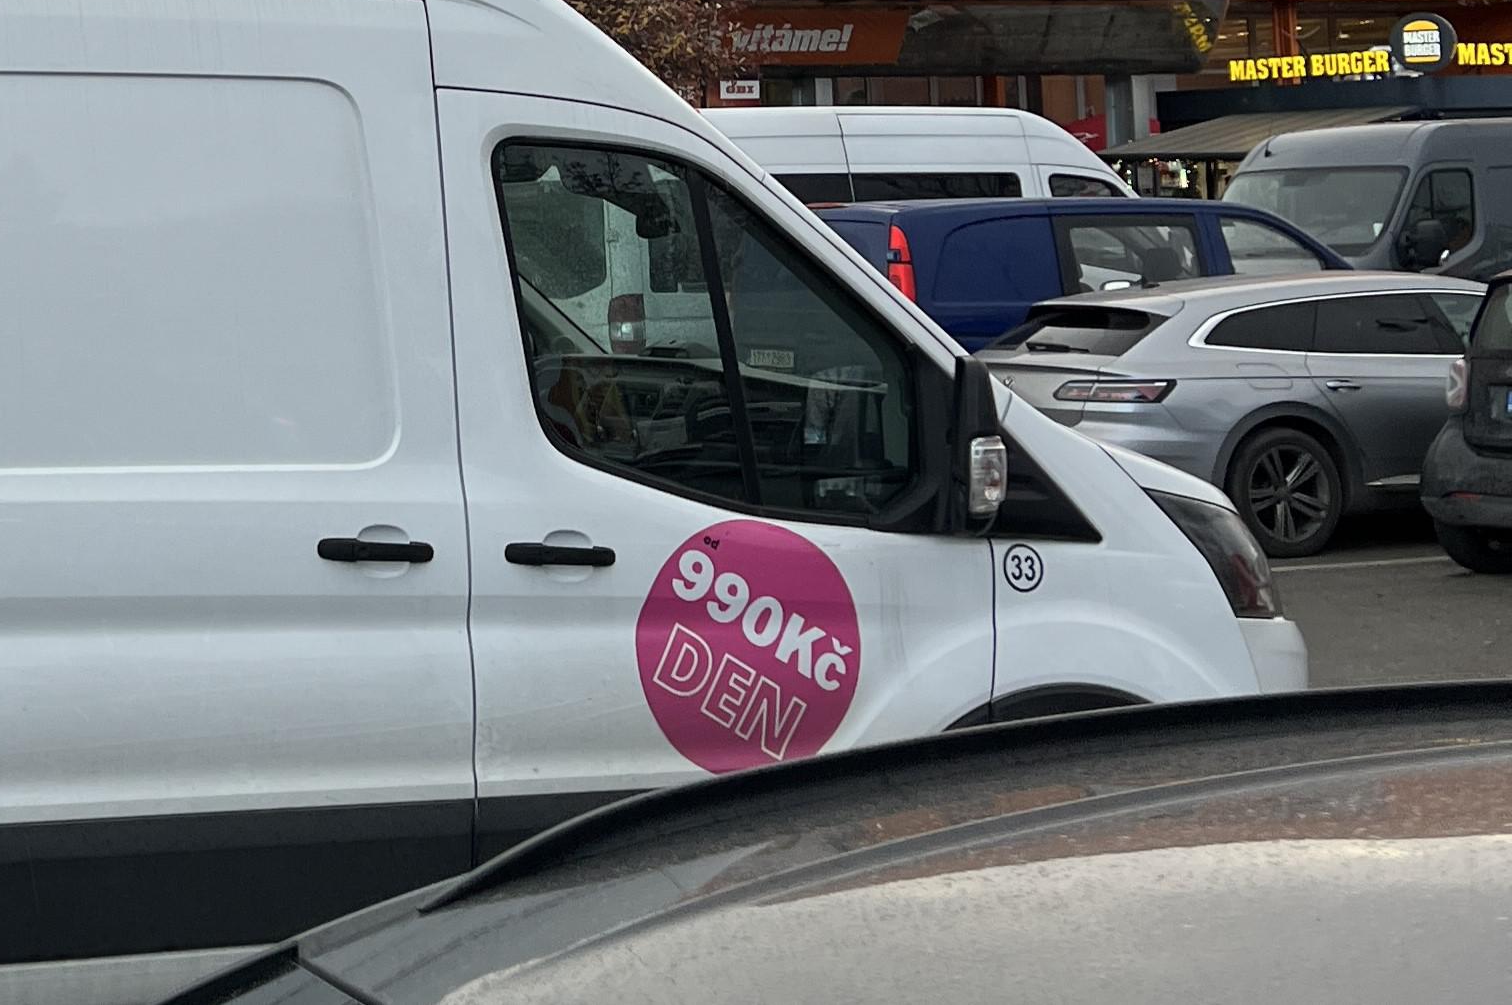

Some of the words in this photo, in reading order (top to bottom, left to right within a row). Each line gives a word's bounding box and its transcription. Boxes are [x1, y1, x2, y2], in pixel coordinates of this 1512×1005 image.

[1403, 31, 1440, 43] MASTER
[1229, 55, 1307, 81] MASTER
[1310, 50, 1390, 77] BURGER
[703, 535, 720, 550] od
[1011, 555, 1036, 581] 33
[672, 549, 853, 691] 990Kč
[653, 622, 808, 761] DEN
